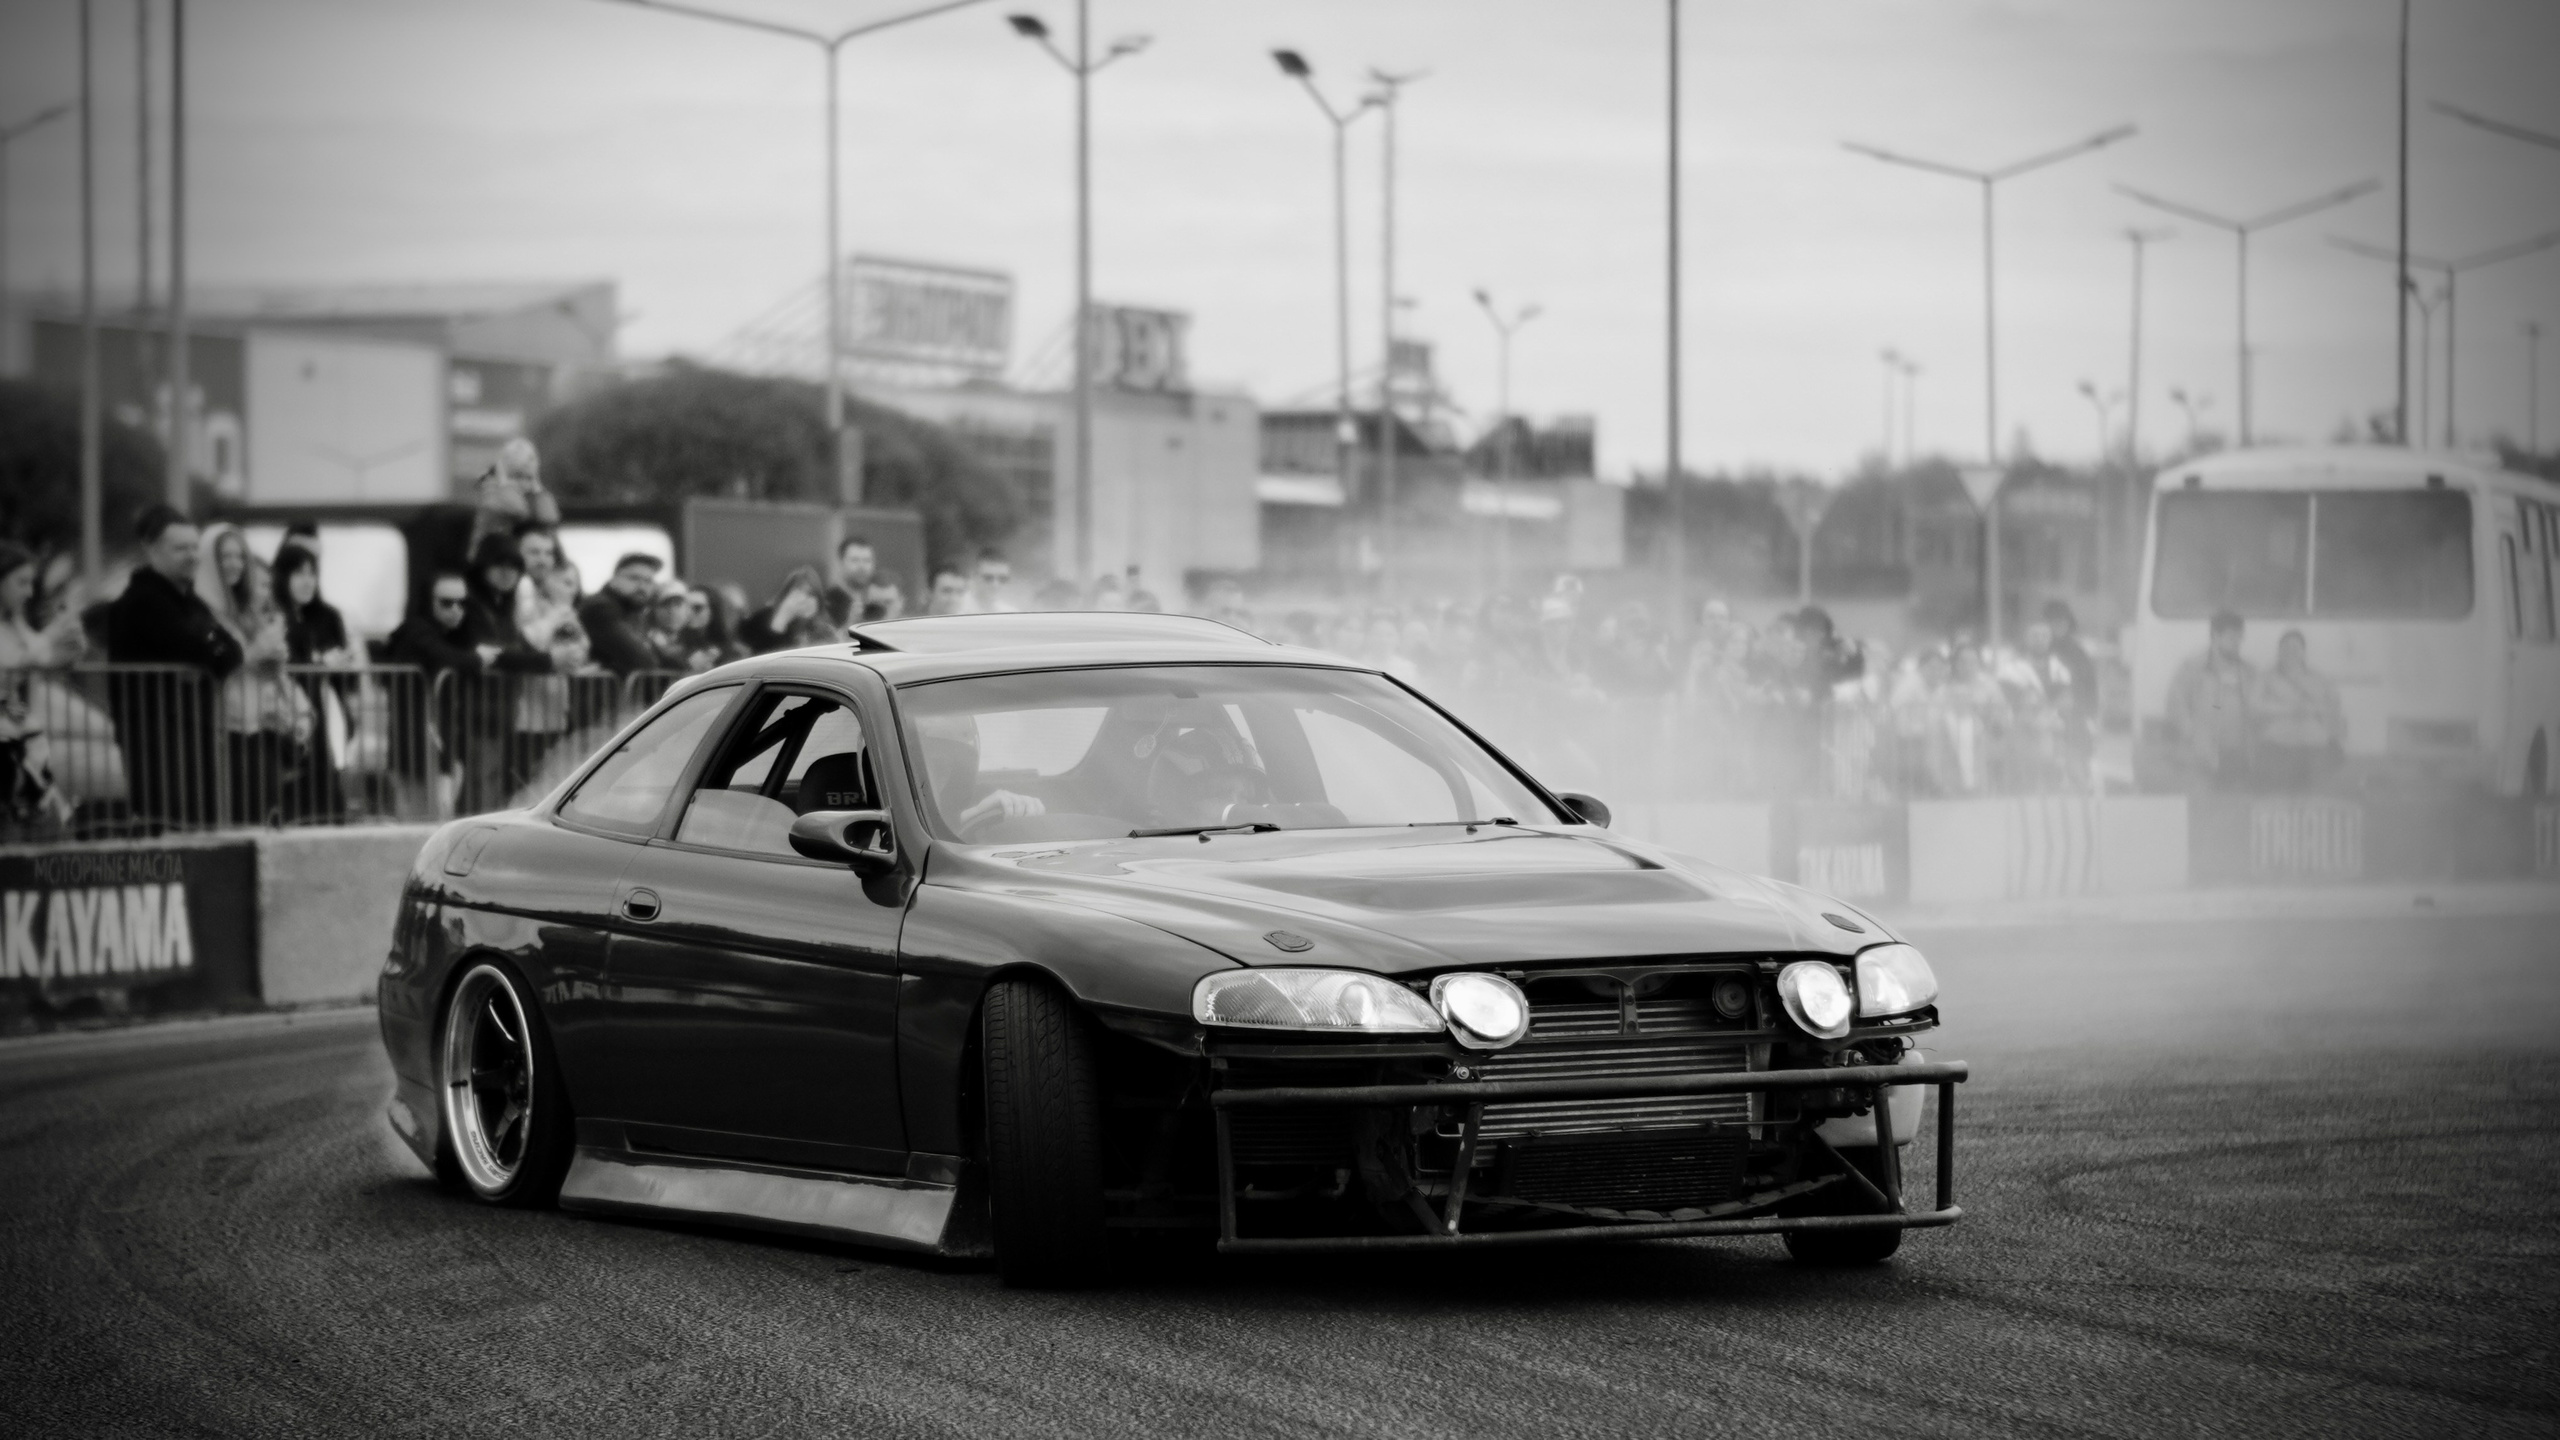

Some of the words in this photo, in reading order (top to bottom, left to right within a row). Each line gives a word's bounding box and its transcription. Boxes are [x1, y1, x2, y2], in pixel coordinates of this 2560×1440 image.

[34, 854, 125, 883] МОТОРНЫЕ
[128, 853, 184, 881] МАСЛА
[0, 881, 193, 978] KAYAMA
